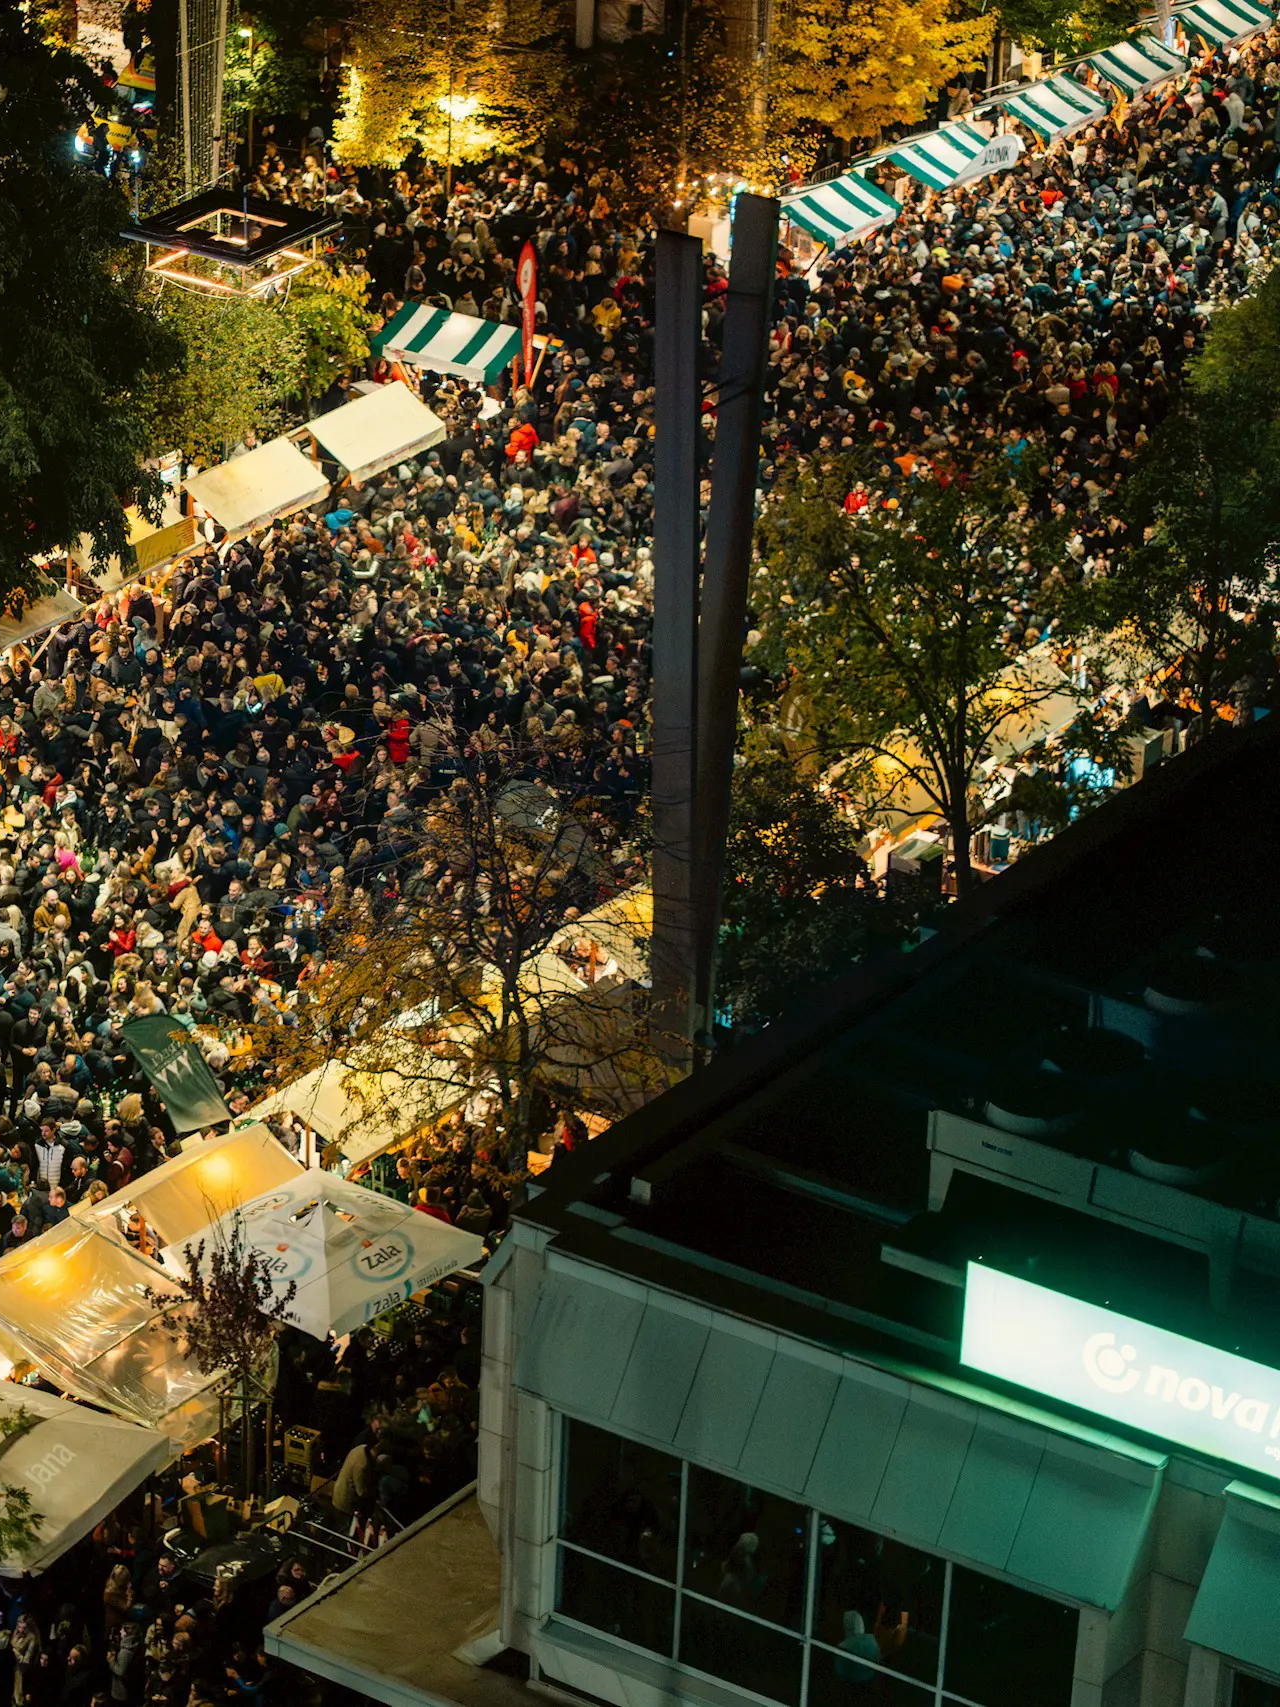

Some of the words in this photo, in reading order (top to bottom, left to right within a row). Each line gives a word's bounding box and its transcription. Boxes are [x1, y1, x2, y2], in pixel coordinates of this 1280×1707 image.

[360, 1244, 402, 1270] Zala
[373, 1290, 402, 1315] Zala
[1144, 1364, 1280, 1439] nova
[24, 1443, 78, 1495] Jana
